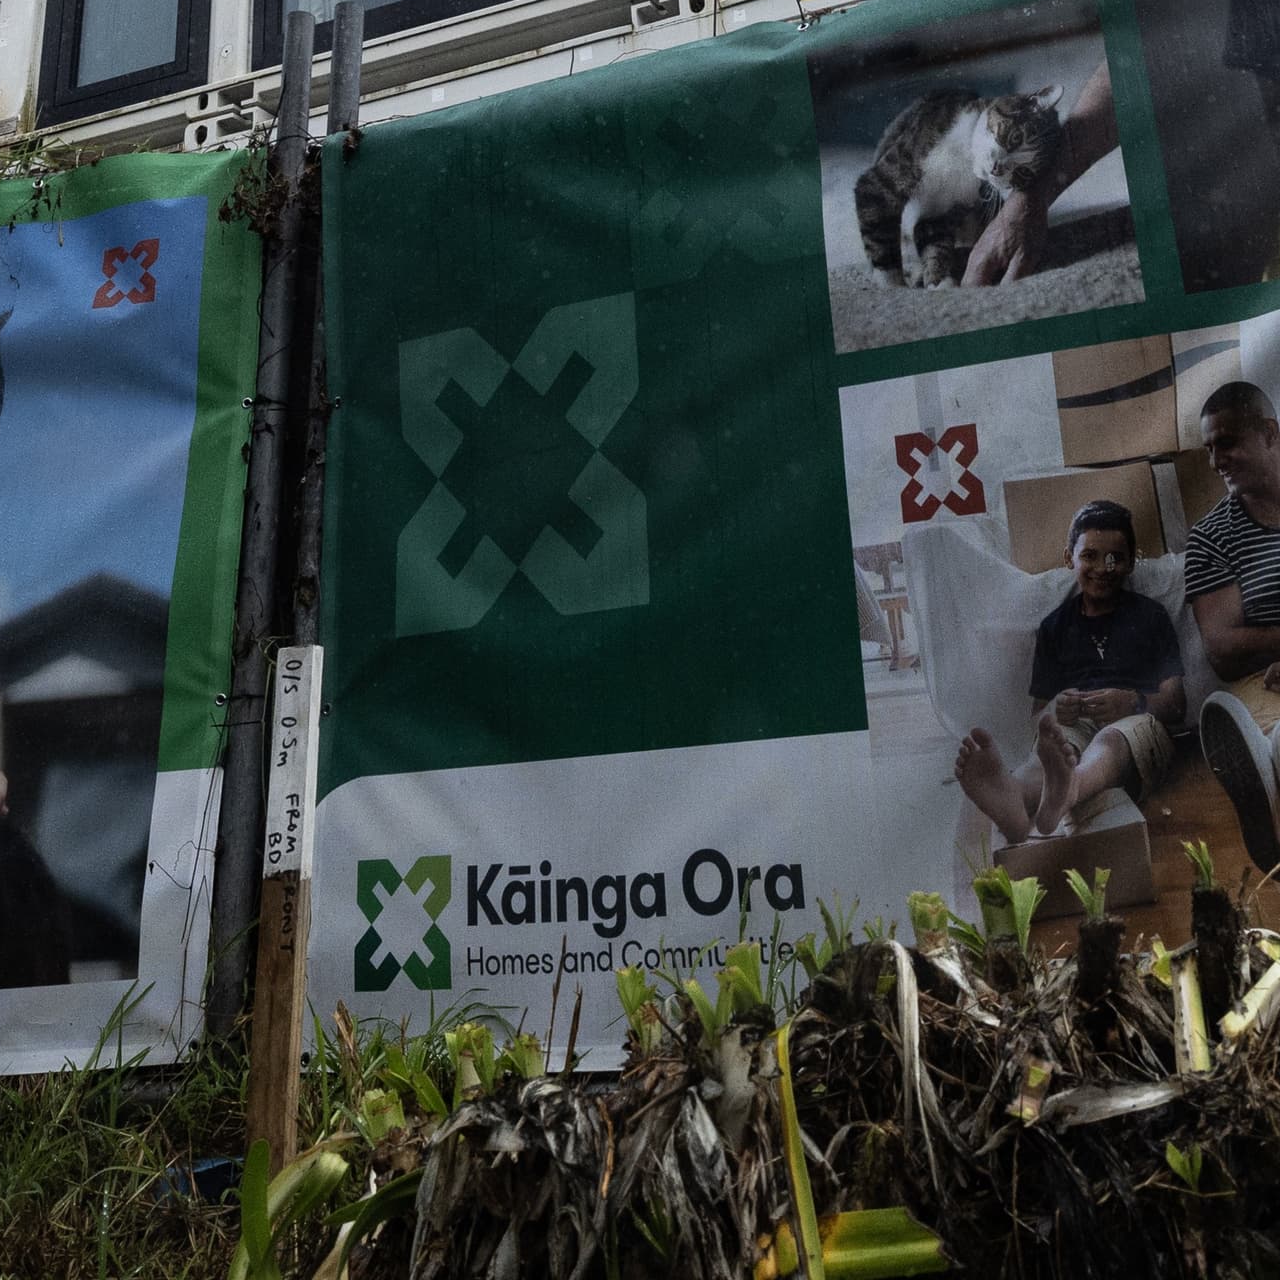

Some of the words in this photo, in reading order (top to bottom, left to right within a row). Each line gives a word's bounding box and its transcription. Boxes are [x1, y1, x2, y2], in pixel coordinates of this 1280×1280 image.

[286, 793, 300, 854] FROM
[466, 859, 667, 939] Kāinga
[682, 848, 806, 916] Ora
[466, 945, 554, 977] Homes
[563, 942, 614, 974] and
